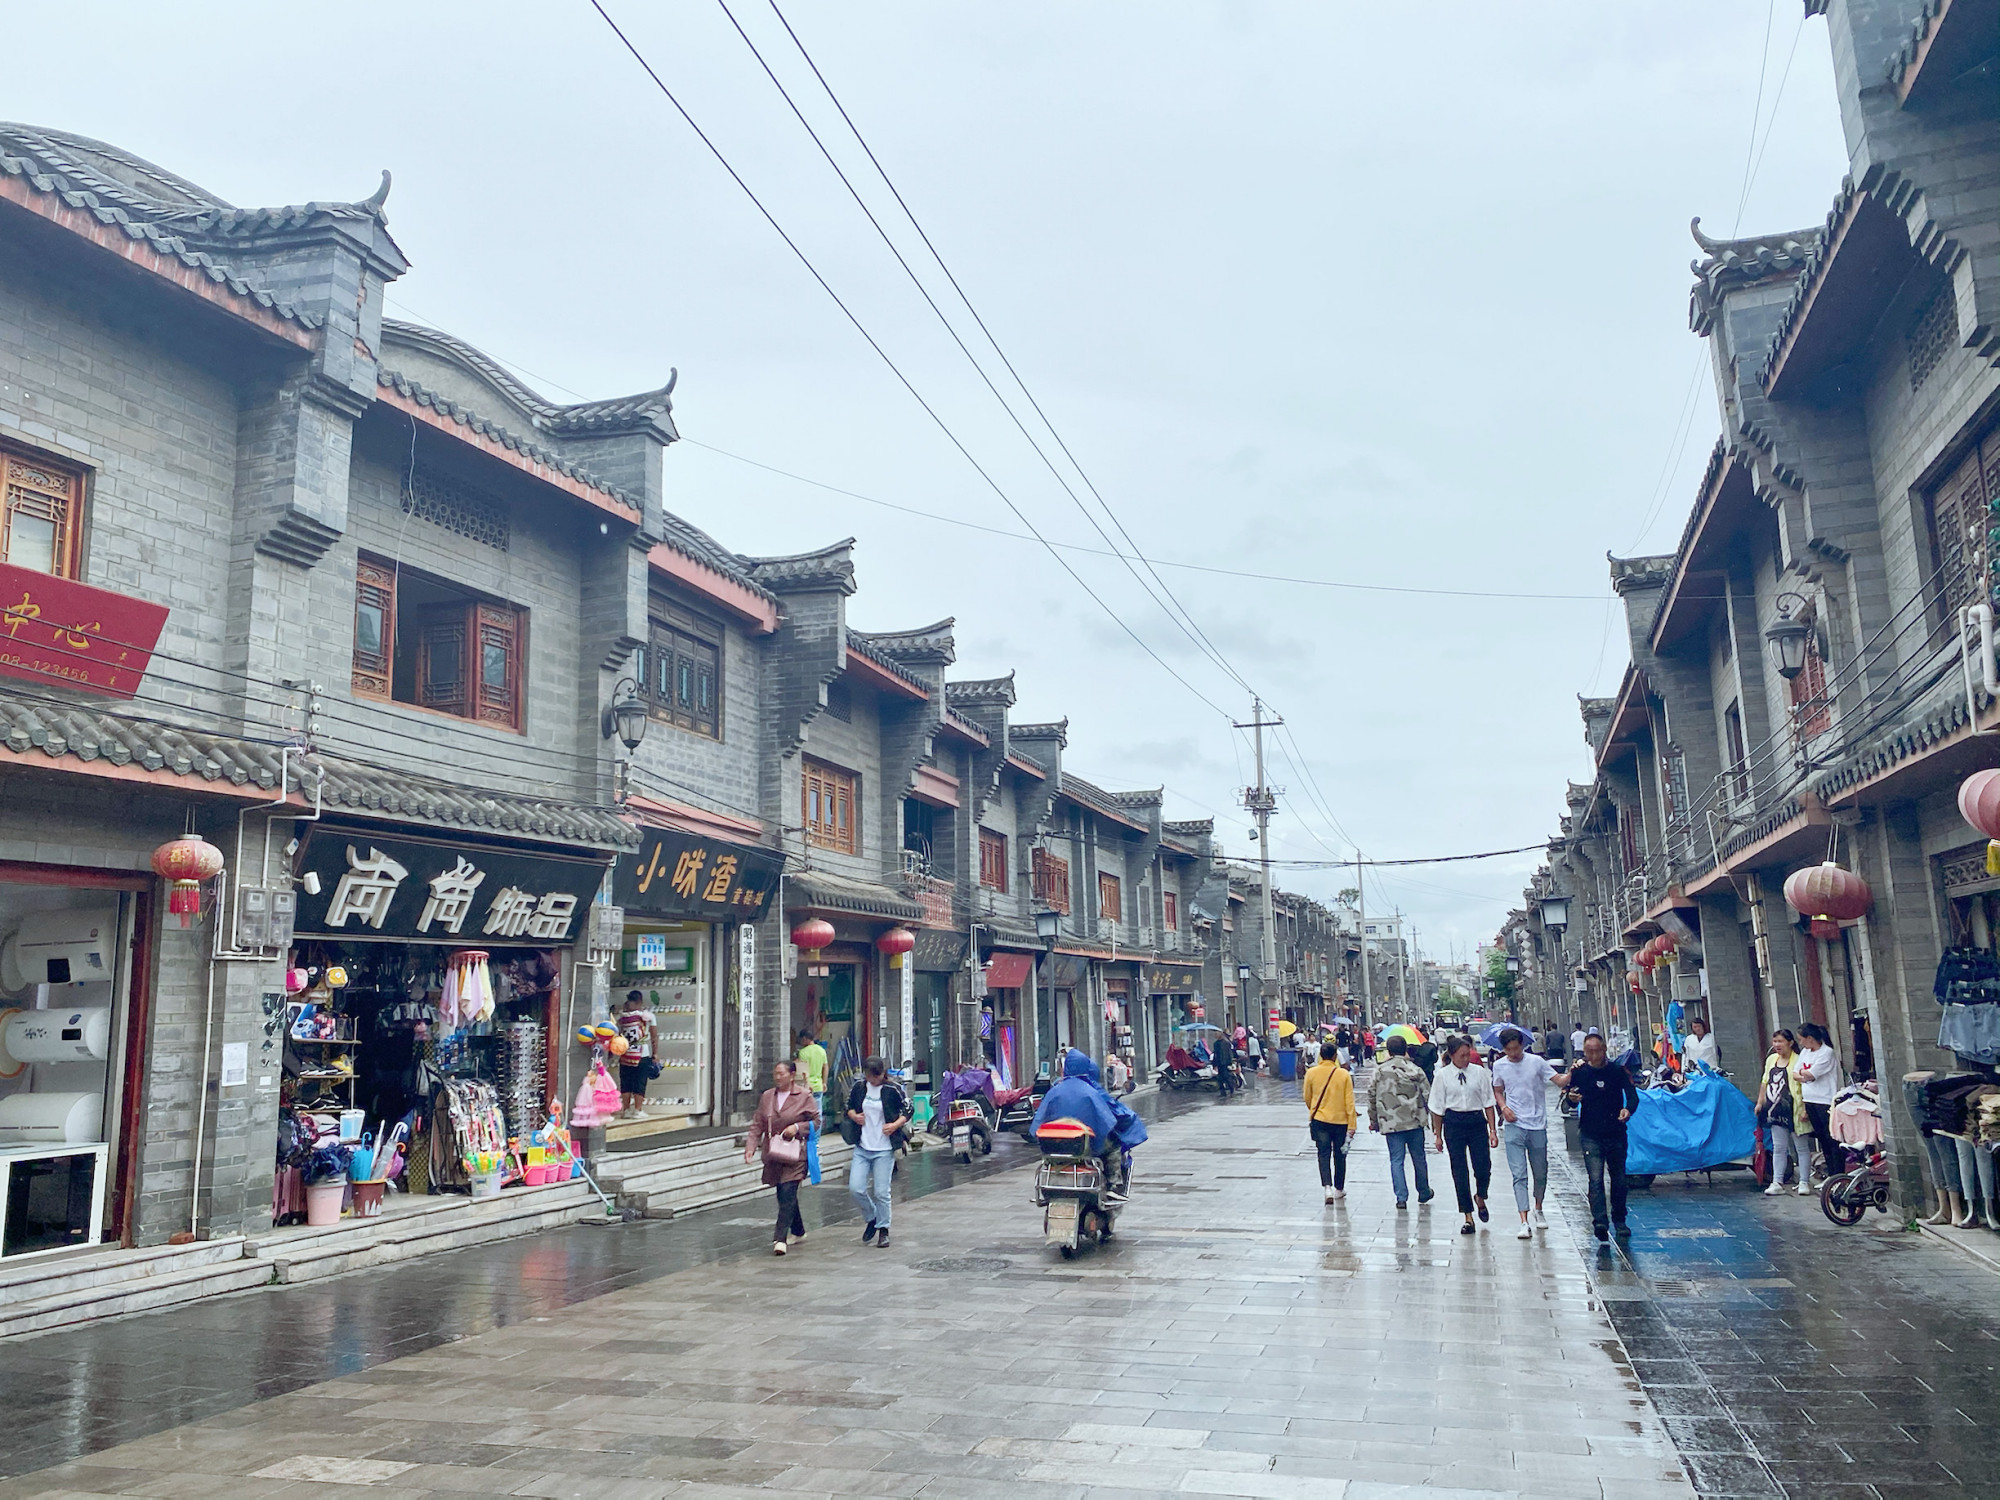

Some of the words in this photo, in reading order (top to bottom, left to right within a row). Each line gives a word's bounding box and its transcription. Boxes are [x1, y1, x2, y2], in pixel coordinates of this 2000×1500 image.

[3, 592, 101, 649] 中心
[636, 841, 738, 903] 小咪渣
[742, 927, 753, 1087] 昭通市档案用品服务中心
